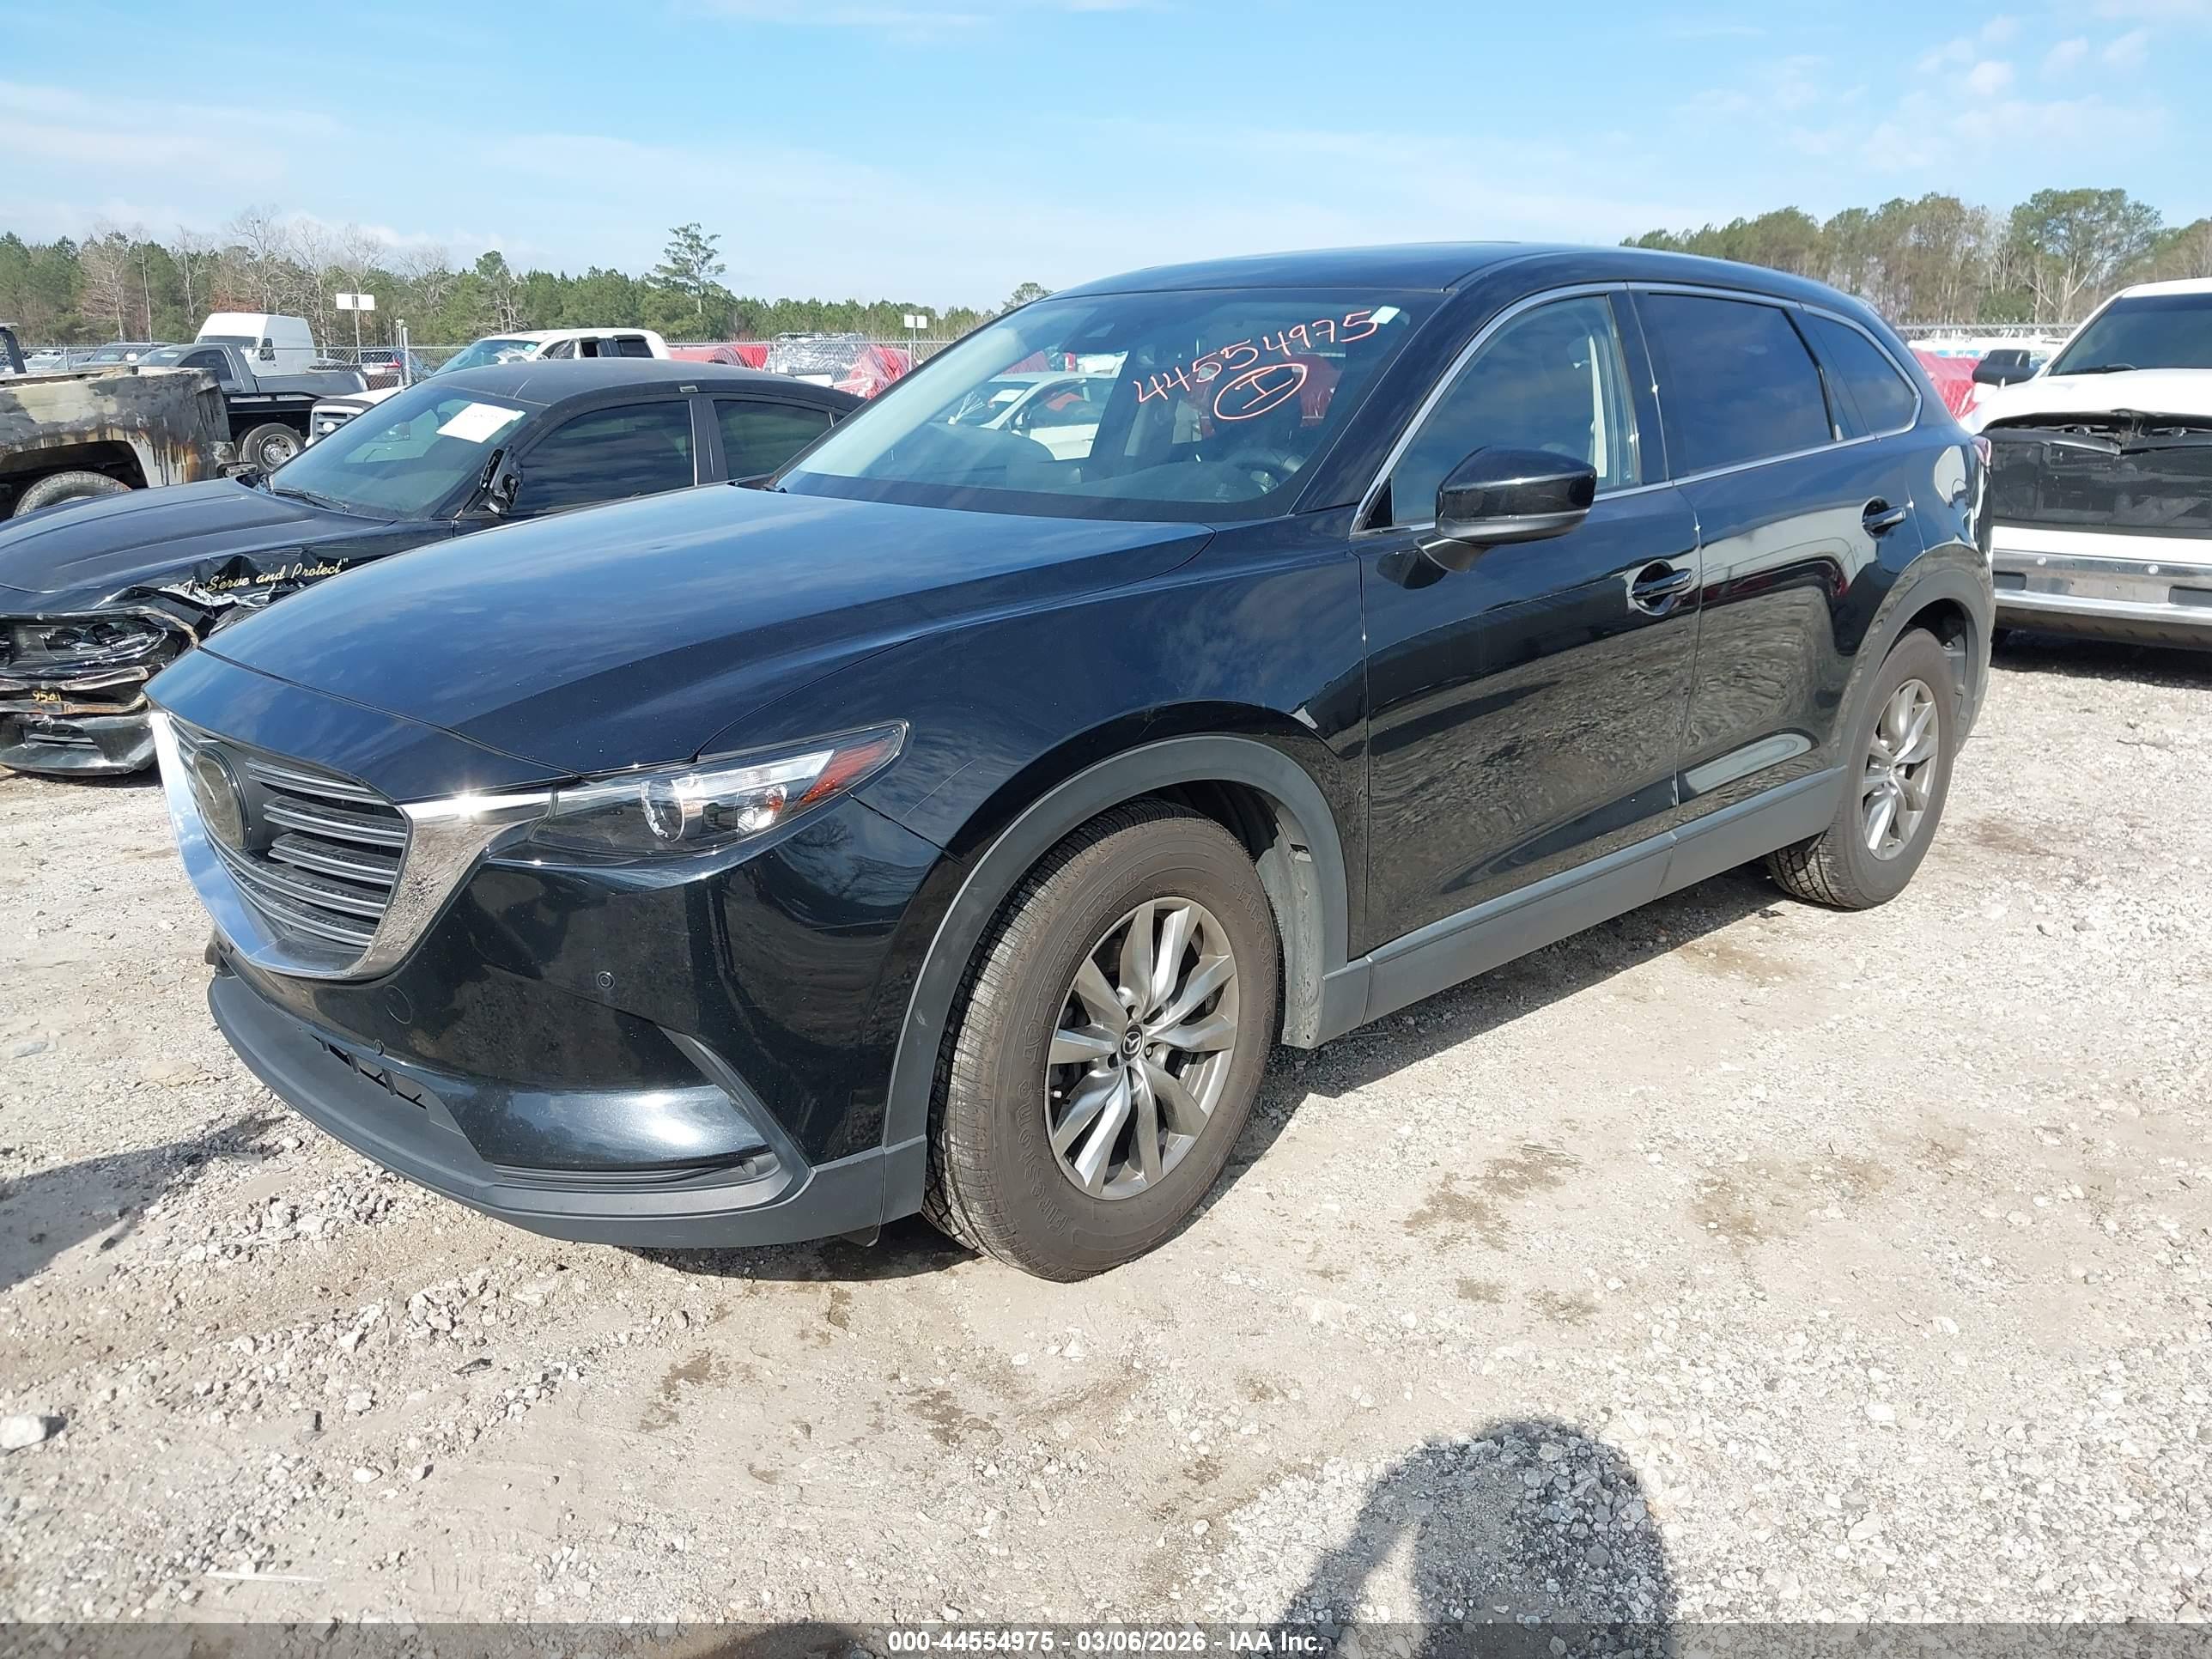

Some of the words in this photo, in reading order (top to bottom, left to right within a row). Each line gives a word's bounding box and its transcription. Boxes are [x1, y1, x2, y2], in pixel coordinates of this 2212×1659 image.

[1133, 310, 1378, 403] 44554975
[206, 574, 249, 592] Serve
[255, 565, 285, 584] and
[1017, 1079, 1070, 1237] Firestone
